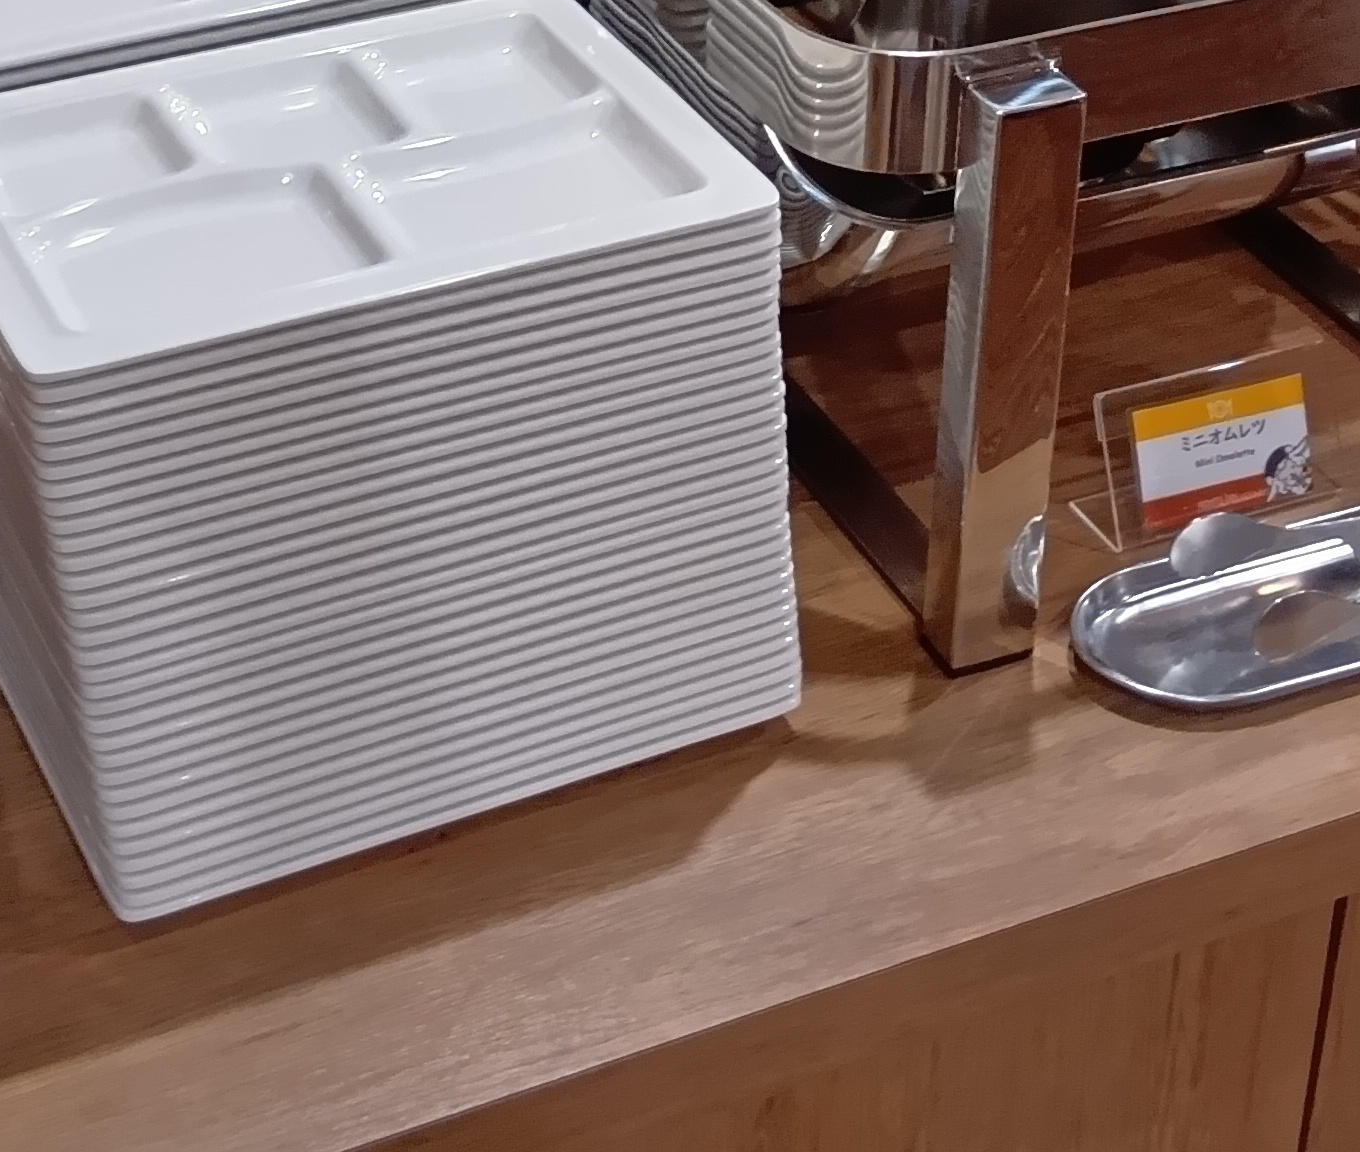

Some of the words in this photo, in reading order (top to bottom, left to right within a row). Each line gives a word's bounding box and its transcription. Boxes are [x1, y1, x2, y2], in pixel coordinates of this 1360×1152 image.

[1181, 419, 1265, 451] ミニオムレツ
